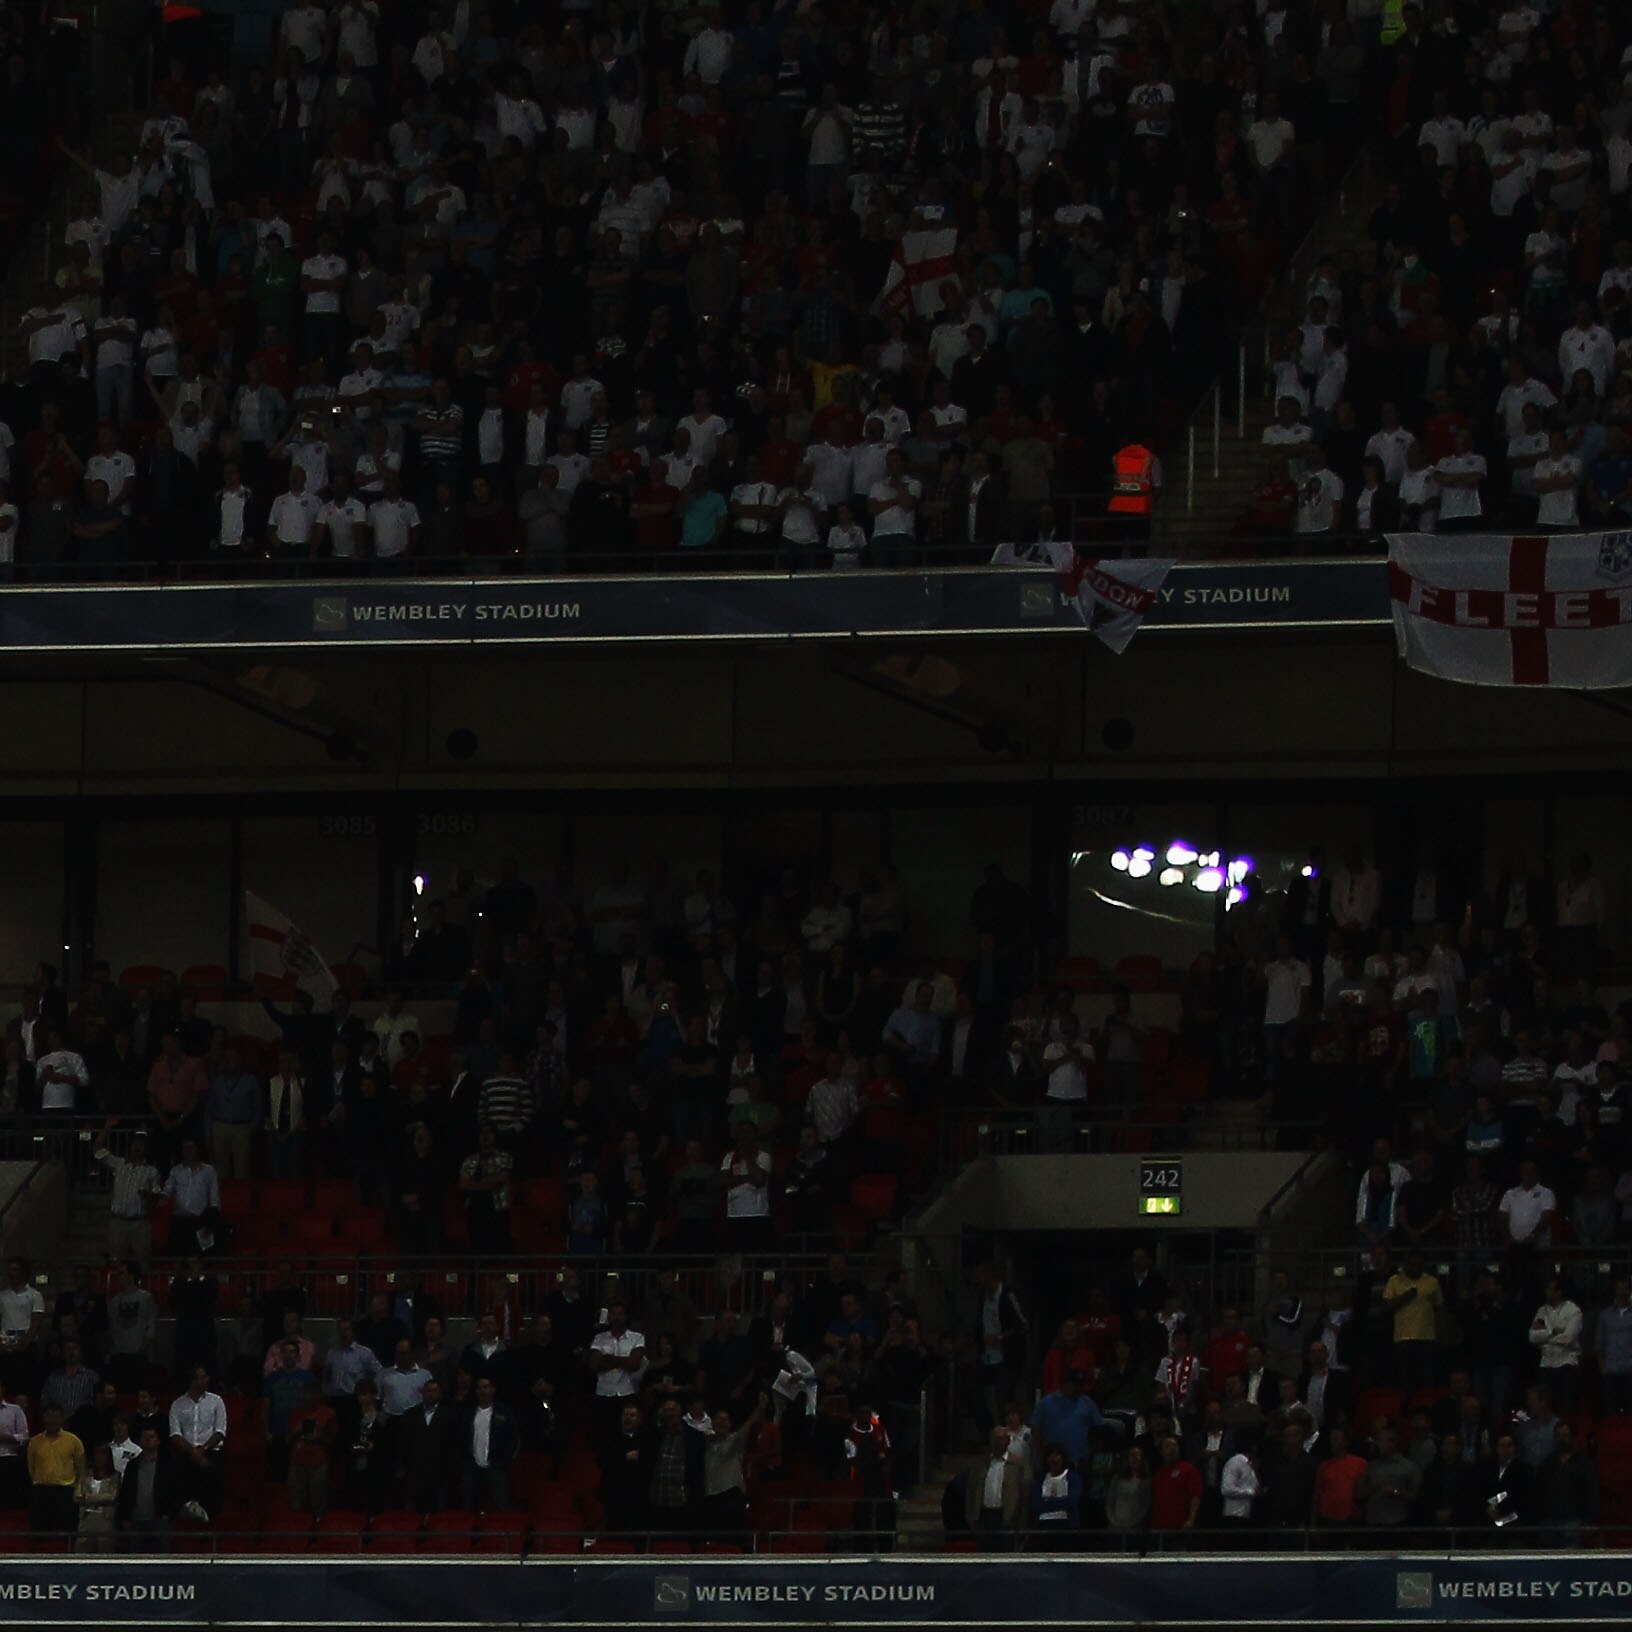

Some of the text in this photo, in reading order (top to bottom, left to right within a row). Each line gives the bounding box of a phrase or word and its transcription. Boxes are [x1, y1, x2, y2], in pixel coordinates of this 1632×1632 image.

[1182, 587, 1291, 604] STADIUM
[1410, 579, 1632, 626] FLEET
[352, 603, 580, 623] WEMBLEY STADIUM
[1142, 1170, 1179, 1188] 242
[85, 1582, 196, 1602] STADIUM
[695, 1583, 935, 1603] WEMBLEY STADIUM
[1438, 1580, 1632, 1601] WEMBLEY STAD
